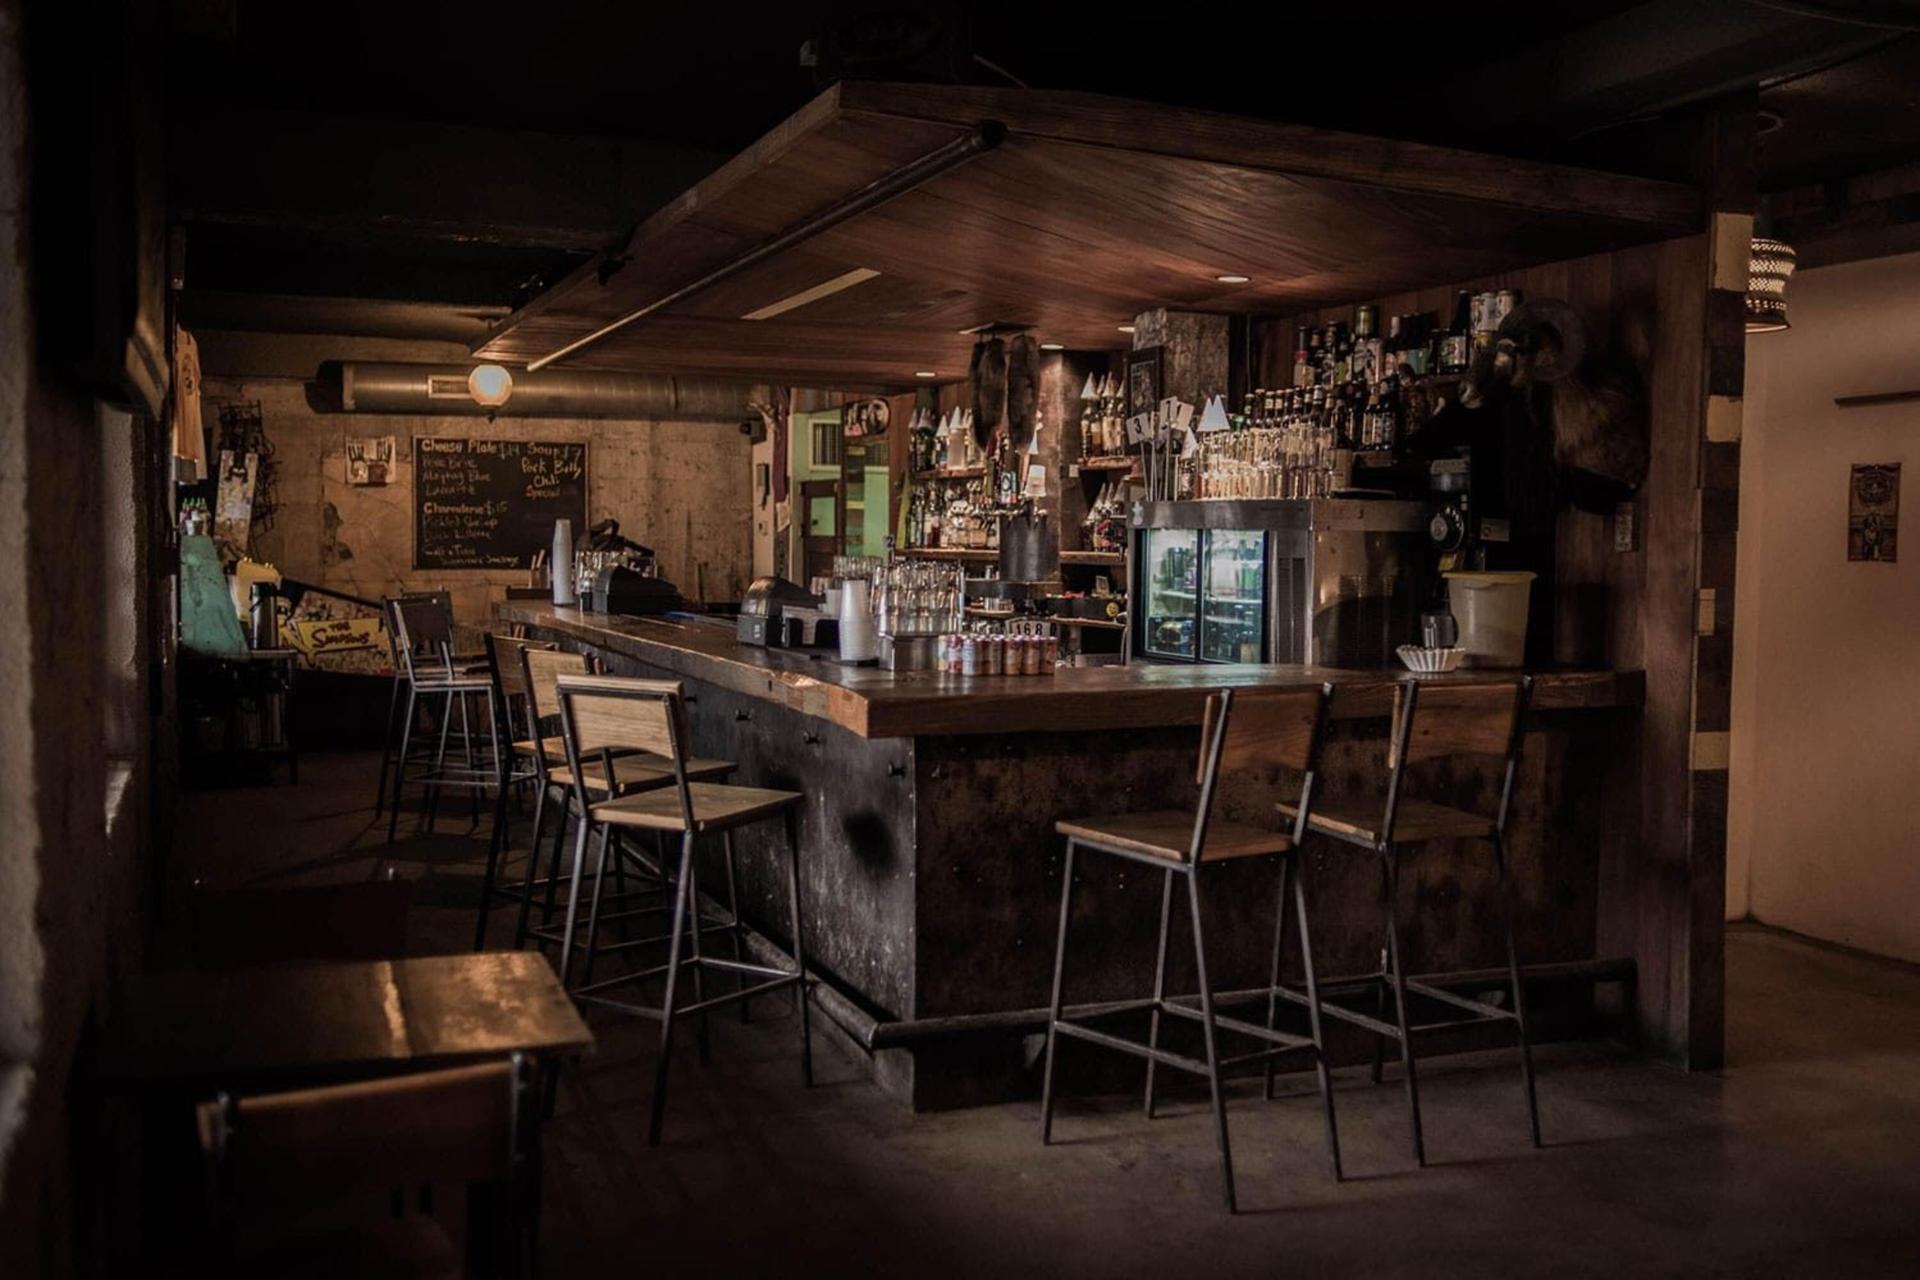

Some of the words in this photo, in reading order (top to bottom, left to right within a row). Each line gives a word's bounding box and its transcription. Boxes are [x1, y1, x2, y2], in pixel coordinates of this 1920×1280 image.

[421, 439, 463, 454] Cheese
[467, 440, 498, 454] Plate
[527, 441, 560, 459] Soup
